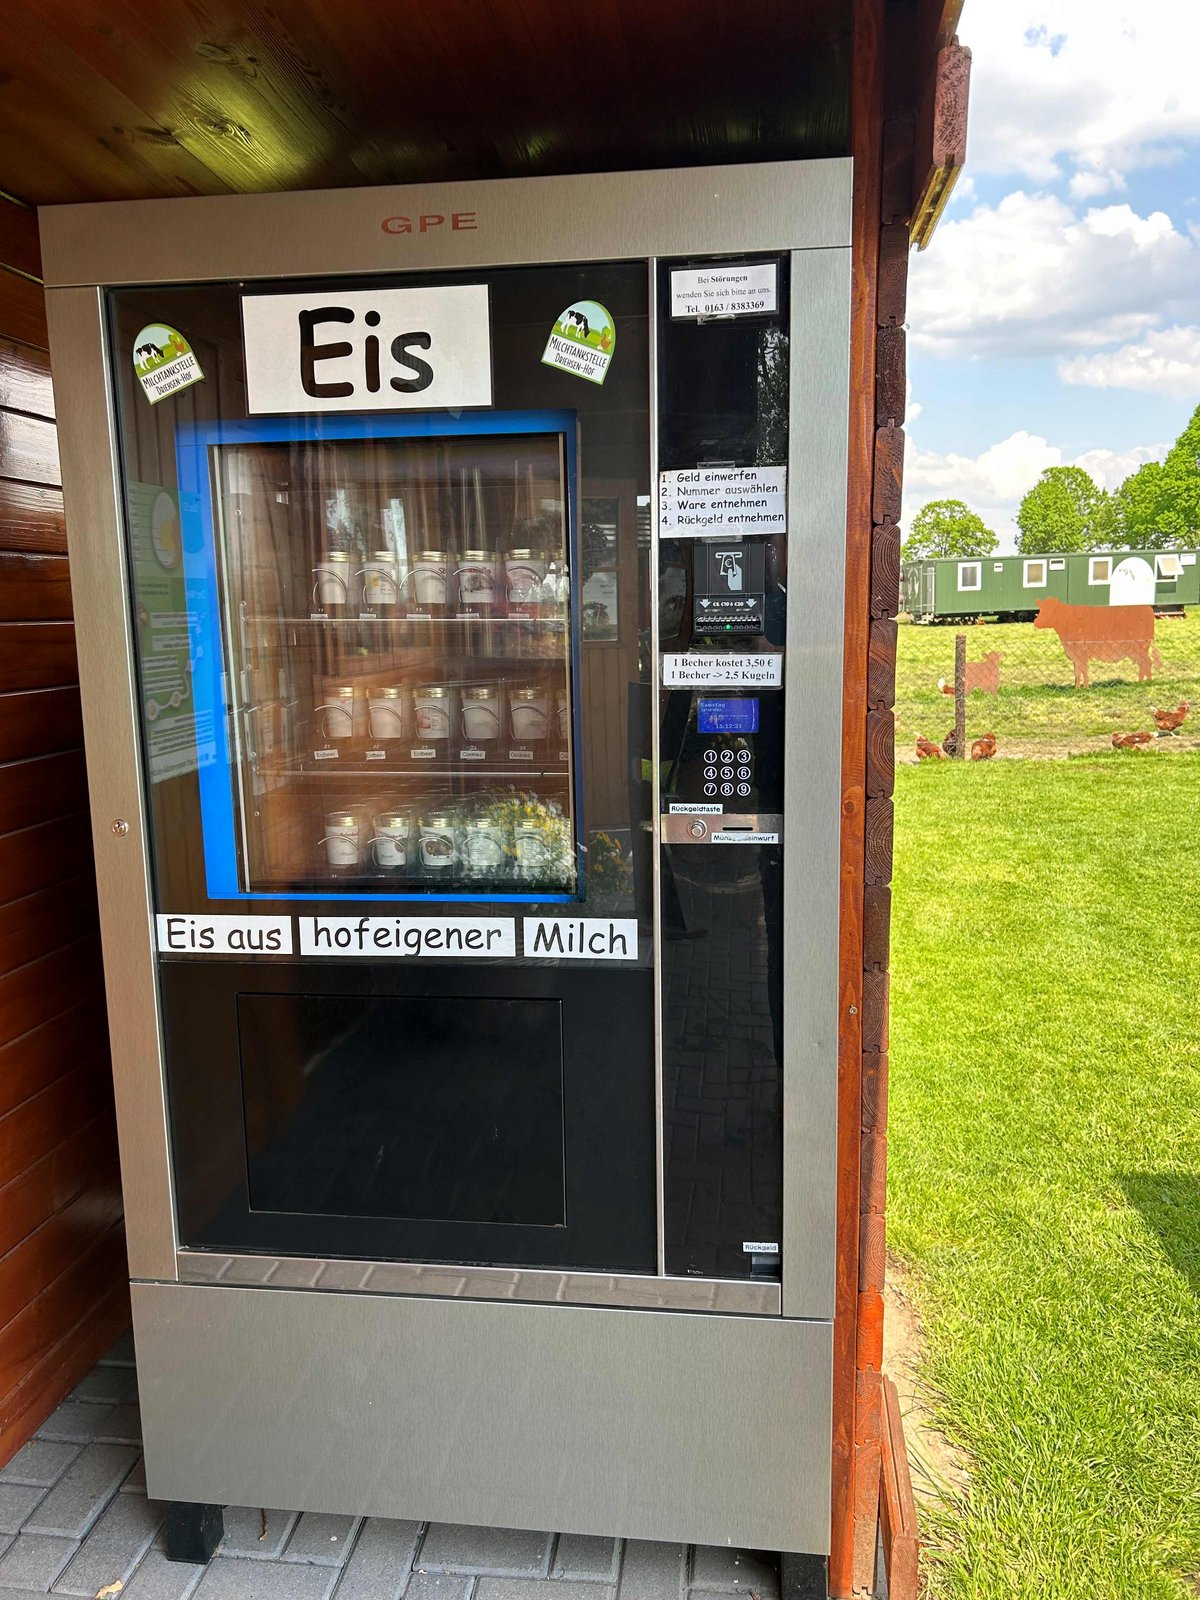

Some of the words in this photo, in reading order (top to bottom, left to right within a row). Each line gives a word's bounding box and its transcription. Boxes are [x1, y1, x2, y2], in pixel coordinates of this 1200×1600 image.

[381, 212, 478, 234] GPE
[697, 276, 709, 284] Bei
[710, 275, 748, 283] Störungen
[676, 291, 702, 299] wenden
[715, 288, 730, 297] sich
[731, 288, 747, 296] bitte
[685, 305, 701, 313] Tel.
[704, 303, 724, 312] 0163
[730, 300, 765, 311] 8383369
[298, 306, 434, 399] Eis
[661, 474, 672, 483] 1.
[676, 472, 700, 483] Geld
[705, 470, 757, 482] einwerfen
[661, 487, 672, 497] 2.
[677, 486, 720, 497] Nummer
[725, 483, 778, 494] auswählen
[661, 501, 672, 511] 3.
[677, 500, 706, 510] Ware
[711, 497, 767, 509] entnehmen
[661, 516, 672, 526] 4.
[677, 514, 723, 527] Rückgeld
[727, 512, 784, 523] entnehmen
[674, 659, 677, 667] 1
[681, 658, 713, 667] Becher
[716, 659, 743, 667] kostet
[745, 659, 765, 668] 3,50
[767, 659, 773, 667] €
[679, 671, 710, 679] Becher
[725, 671, 739, 680] 2,5
[742, 672, 775, 680] Kugeln
[167, 918, 215, 949] Eis
[228, 928, 281, 950] aus
[314, 917, 501, 957] hofeigener
[534, 922, 627, 955] Milch
